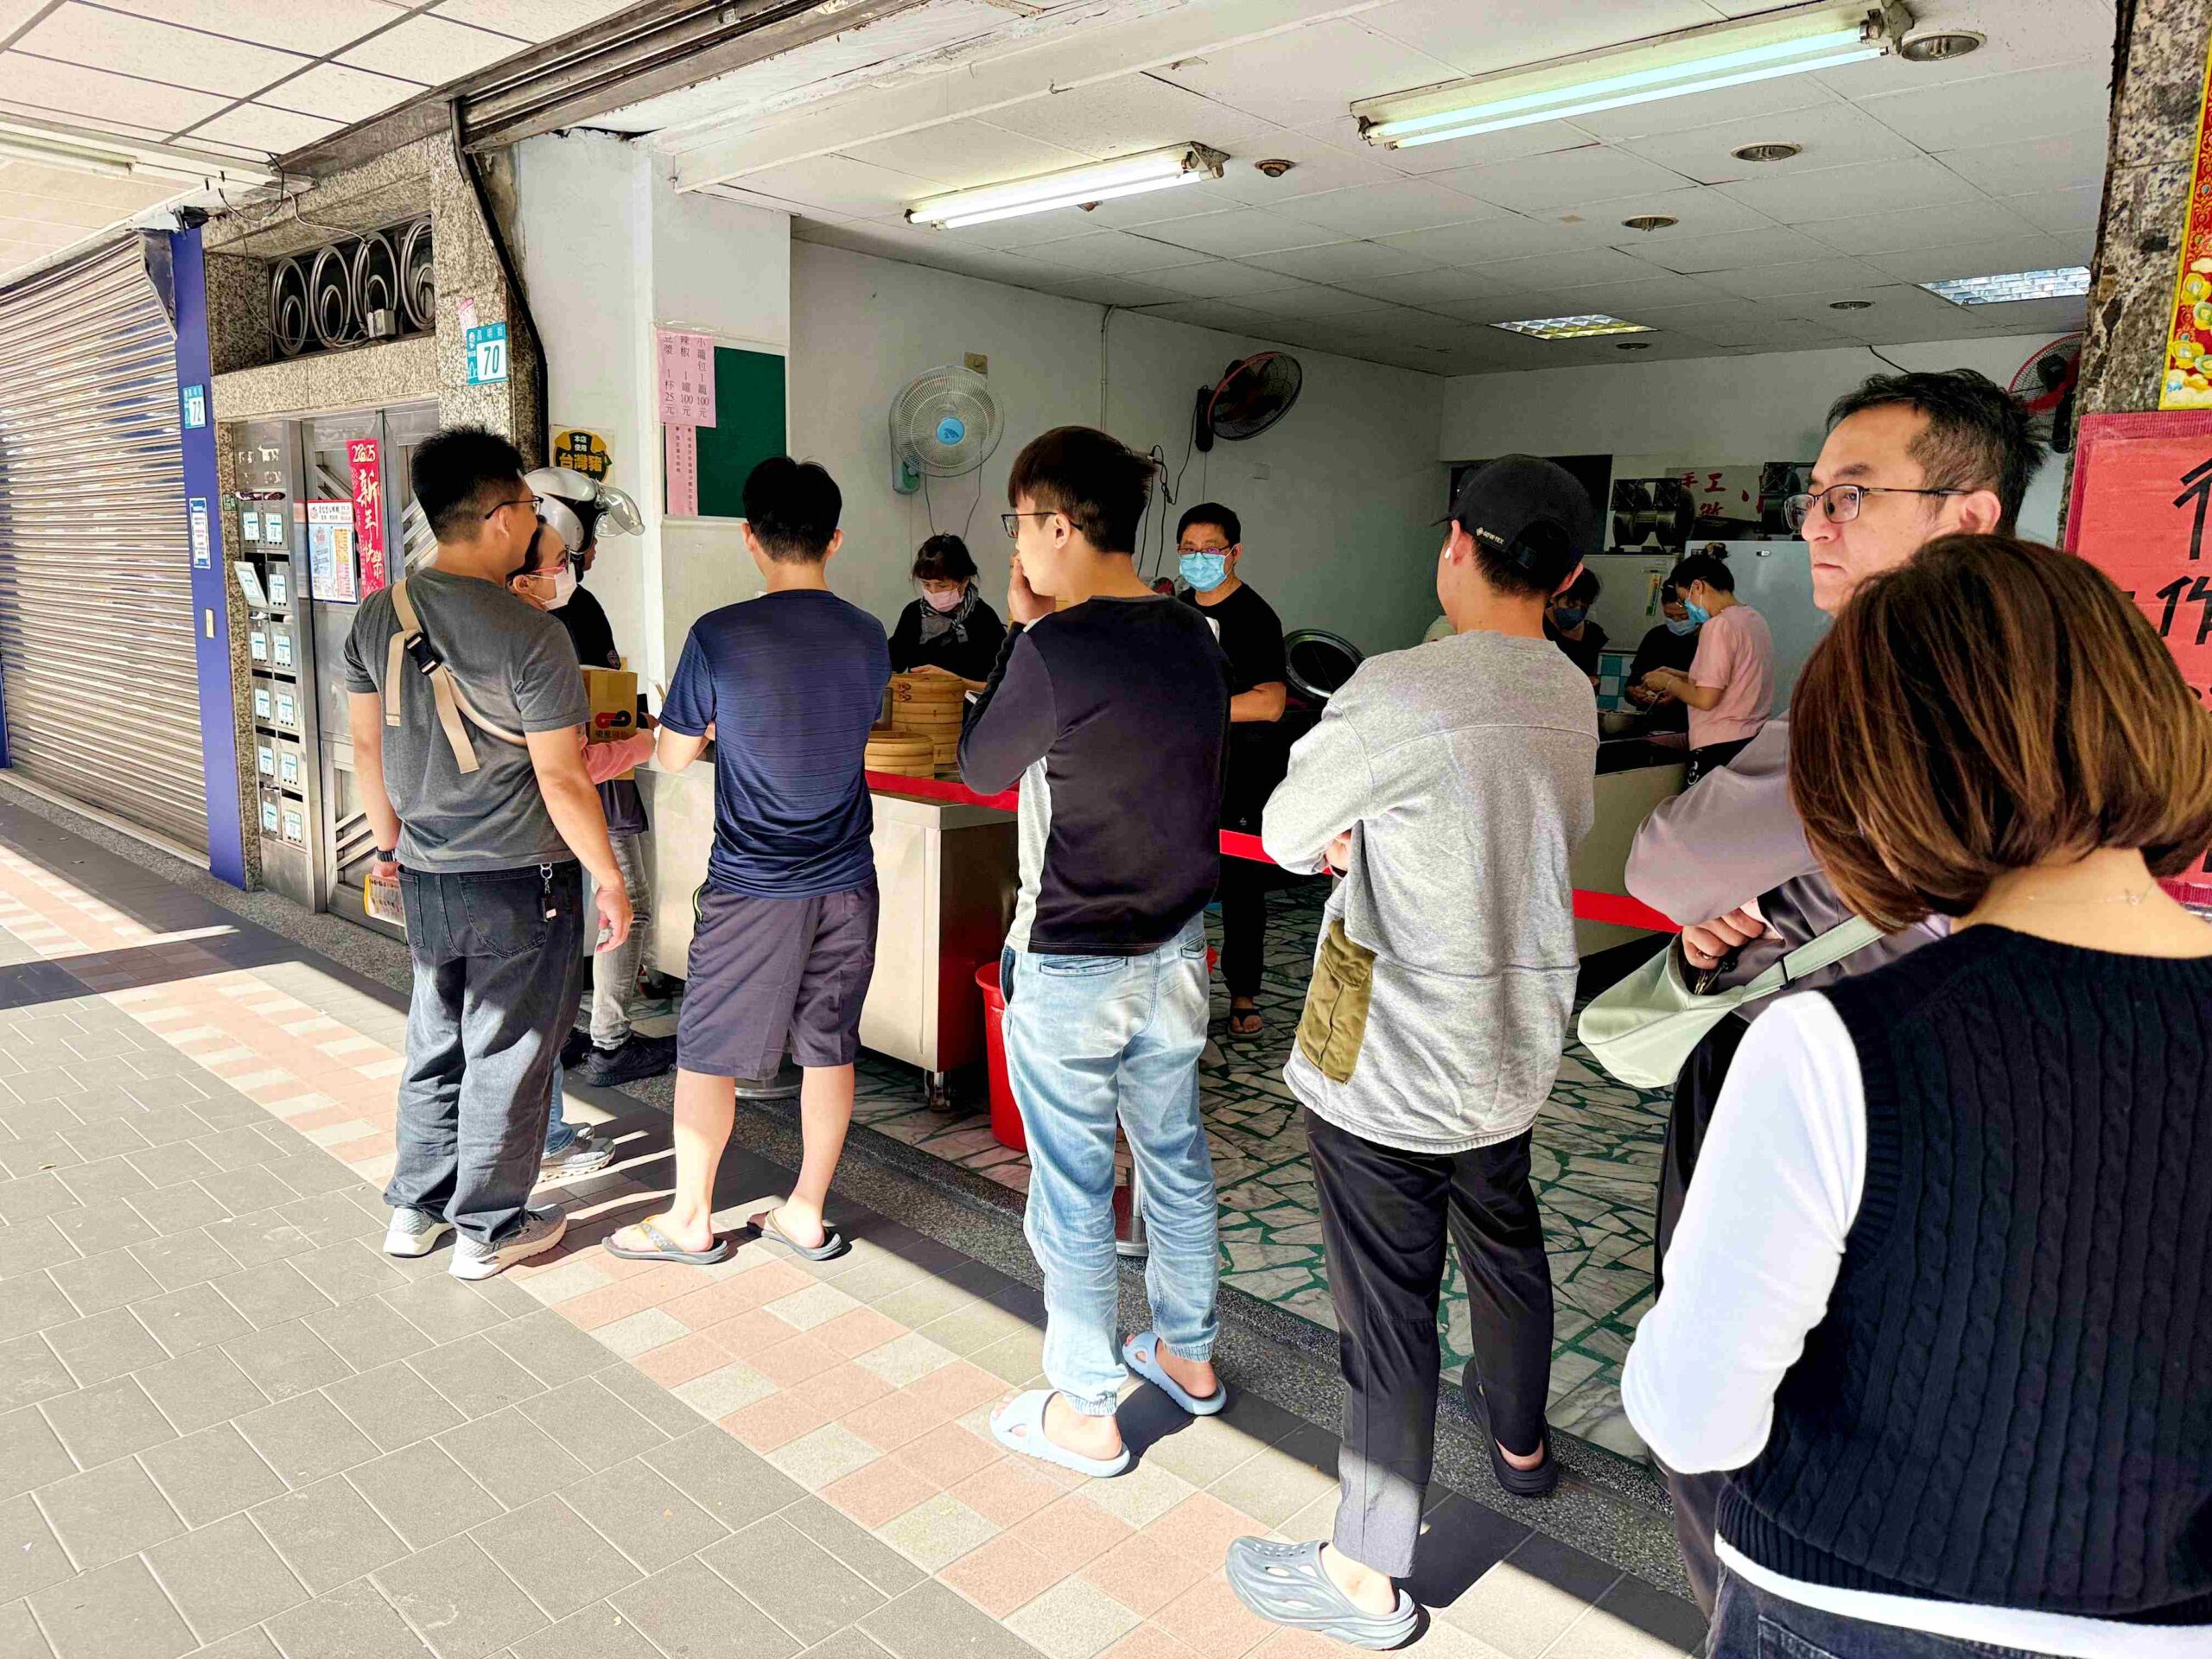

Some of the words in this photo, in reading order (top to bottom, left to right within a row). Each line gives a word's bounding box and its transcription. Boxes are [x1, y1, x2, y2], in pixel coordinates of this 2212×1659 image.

[484, 344, 500, 376] 70
[352, 443, 376, 463] 2025
[1681, 471, 1726, 493] 手工
[356, 468, 384, 581] 新年快樂
